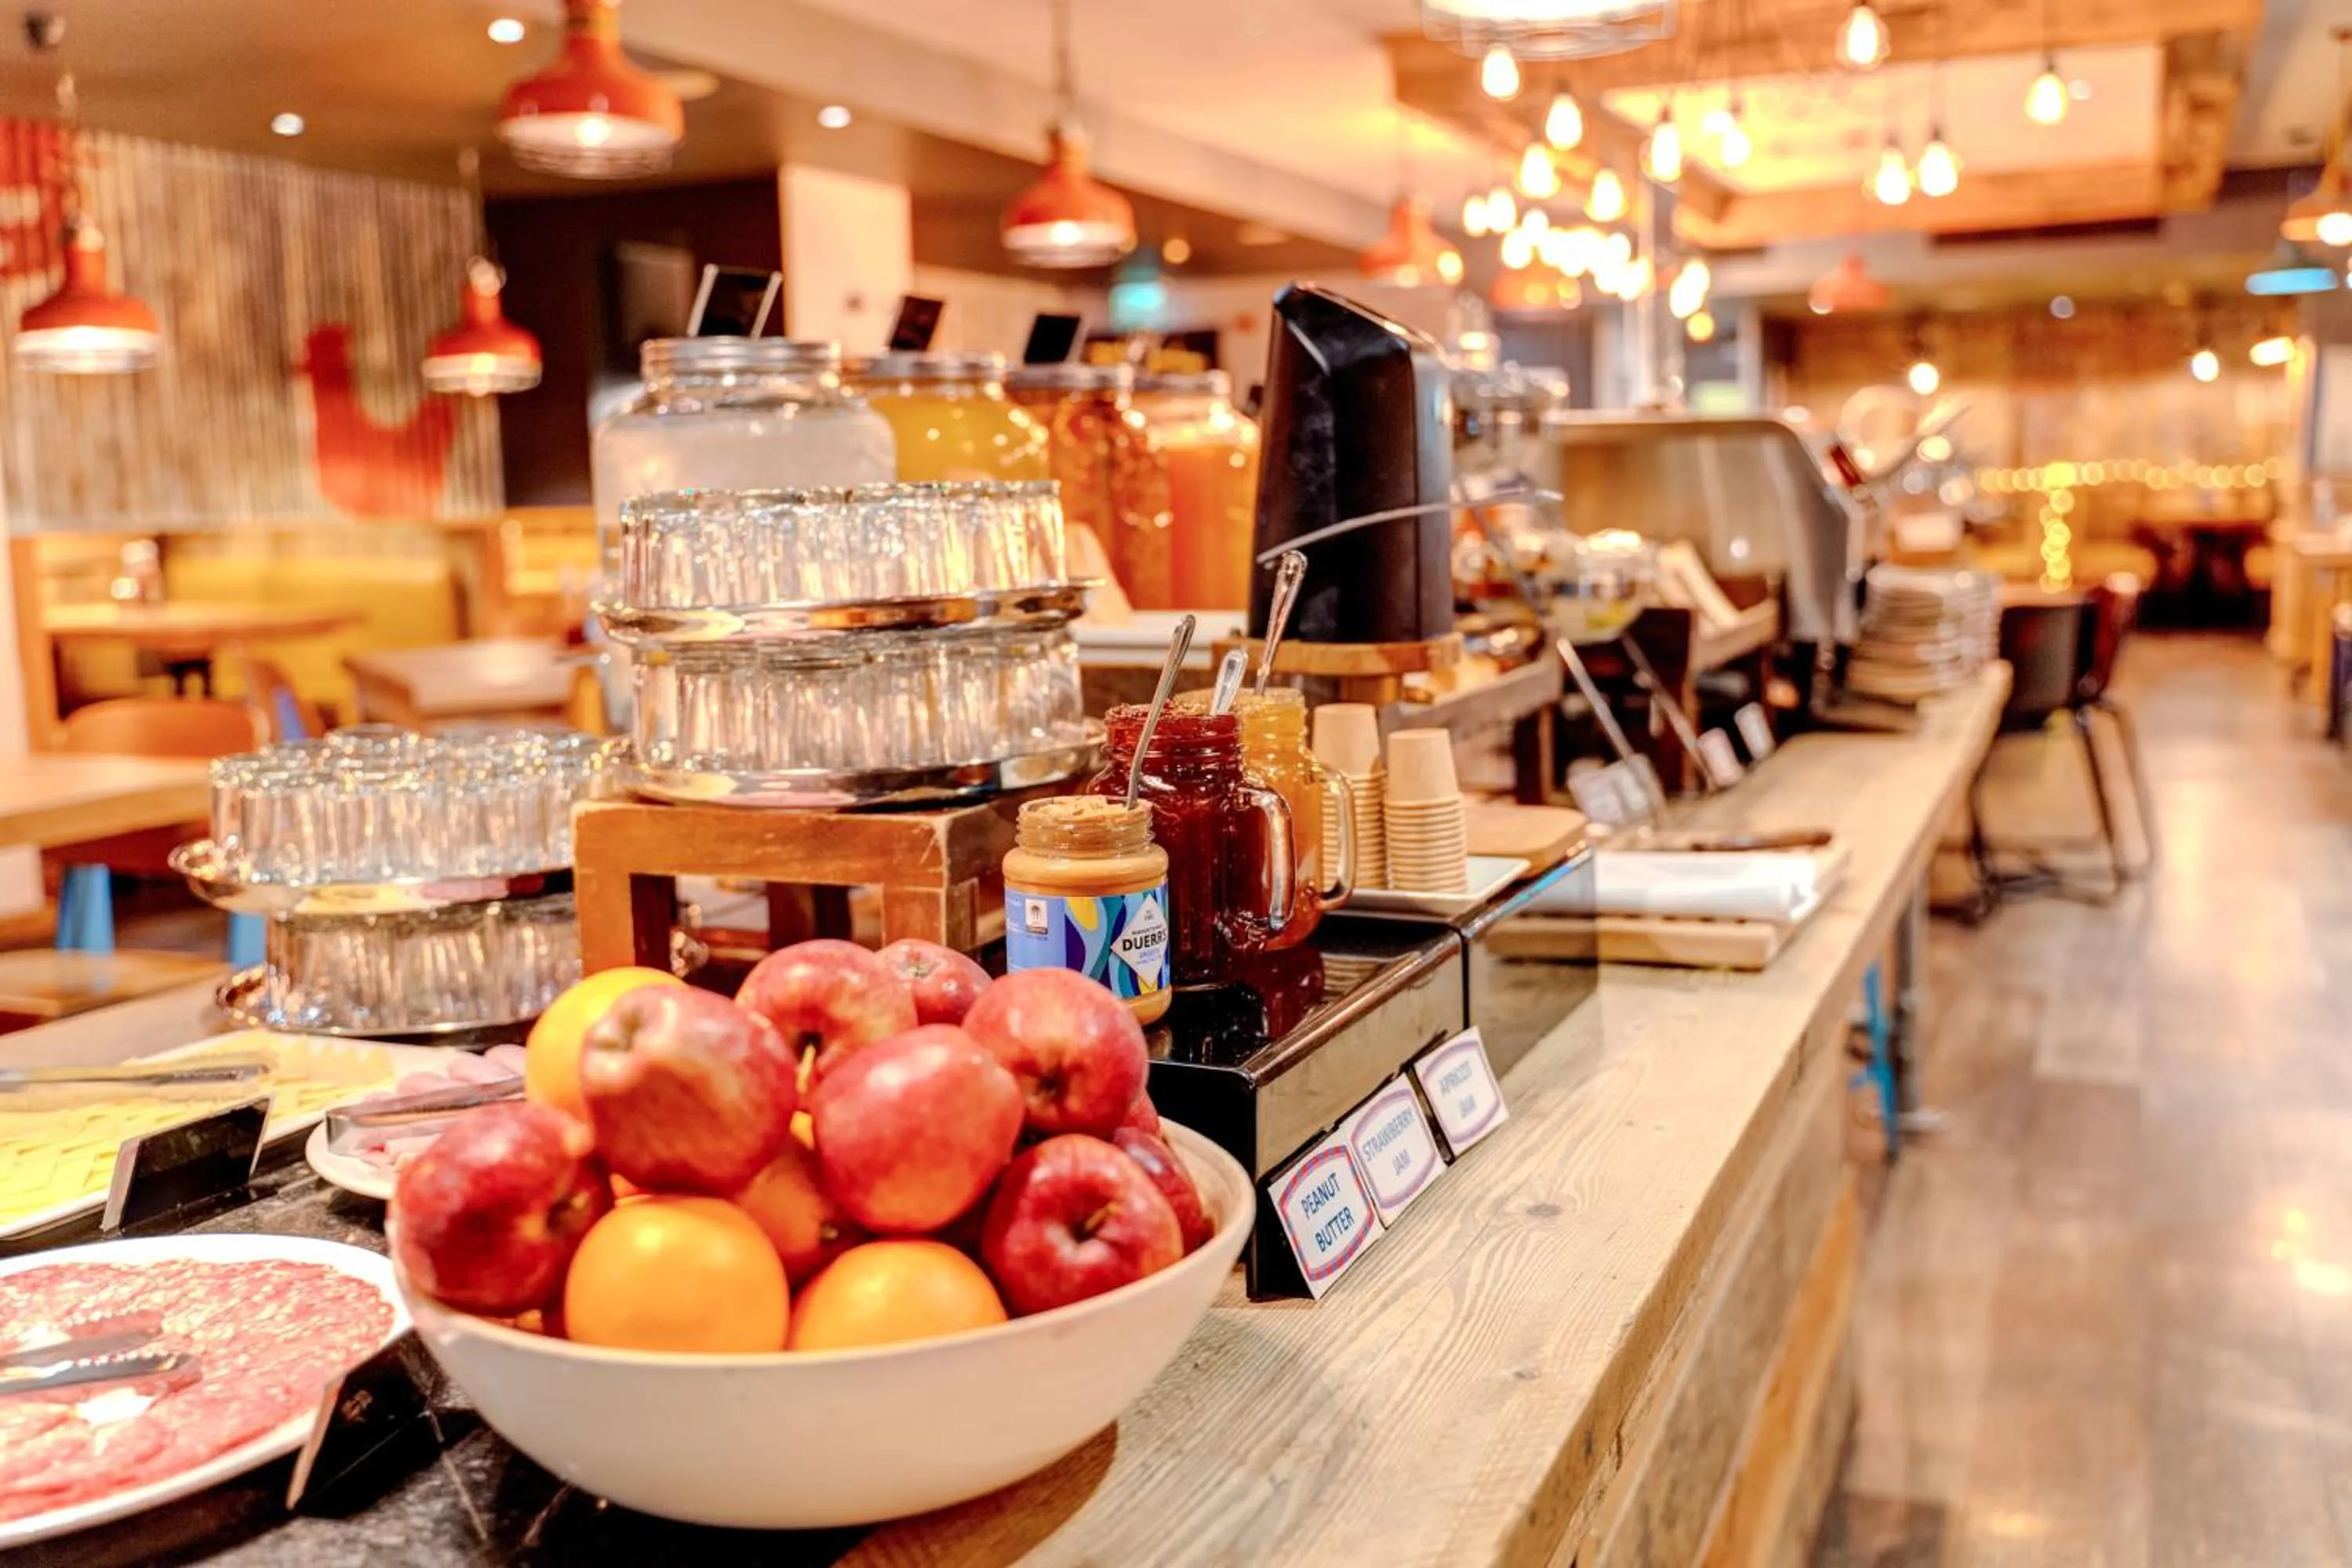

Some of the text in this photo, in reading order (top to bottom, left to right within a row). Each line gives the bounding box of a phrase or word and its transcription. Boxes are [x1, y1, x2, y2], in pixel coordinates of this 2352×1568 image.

[1363, 1107, 1415, 1161] STRAWBERRY
[1392, 1149, 1411, 1176] JAM
[1301, 1172, 1340, 1220] PEANUT
[1315, 1206, 1355, 1252] BUTTER
